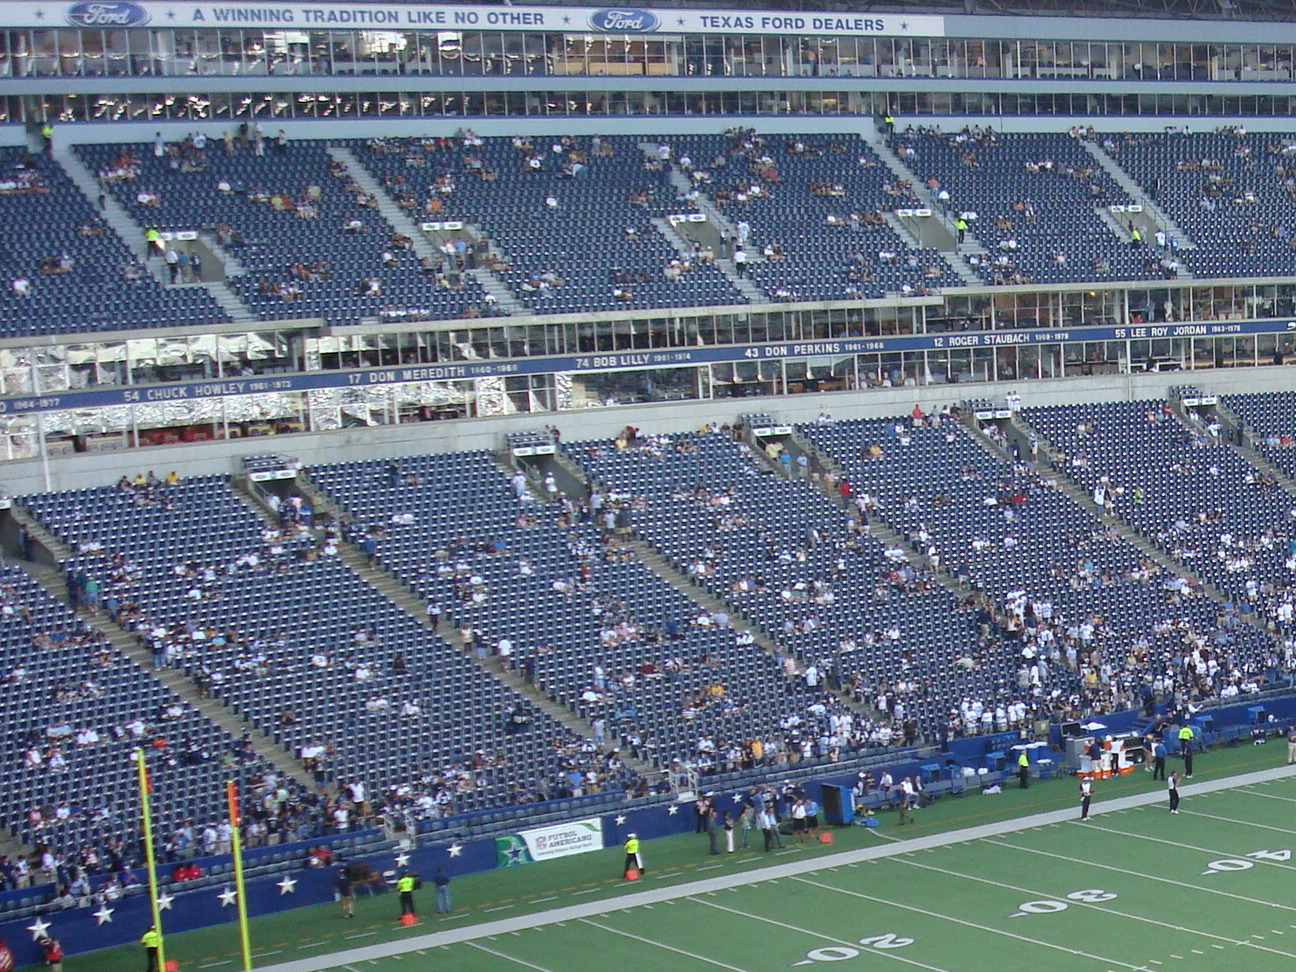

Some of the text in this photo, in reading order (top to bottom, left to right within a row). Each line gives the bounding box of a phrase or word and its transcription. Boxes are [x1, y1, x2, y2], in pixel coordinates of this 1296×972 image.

[193, 8, 544, 26] A WINNING TRADITION LIKE NO OTHER
[700, 16, 886, 32] TEXAS FORD DEALERS
[934, 337, 943, 348] 12
[949, 336, 979, 346] ROGER
[984, 333, 1030, 345] STAUBACH
[1115, 328, 1126, 339] 55
[1131, 327, 1147, 338] LEE
[1151, 327, 1168, 337] ROY
[1173, 325, 1207, 336] JORDAN
[745, 347, 759, 358] 43
[765, 345, 787, 357] DON
[794, 343, 840, 355] PERKINS
[576, 358, 590, 368] 74
[593, 356, 616, 367] BOB
[620, 354, 650, 366] LILLY
[349, 374, 362, 384] 17
[369, 371, 395, 384] DON
[403, 367, 465, 381] MEREDITH
[124, 391, 140, 402] 54
[147, 387, 188, 401] CHUCK
[195, 382, 245, 397] HOWLEY
[1206, 848, 1292, 872] 40
[1019, 888, 1118, 915] 30
[806, 932, 915, 963] 20
